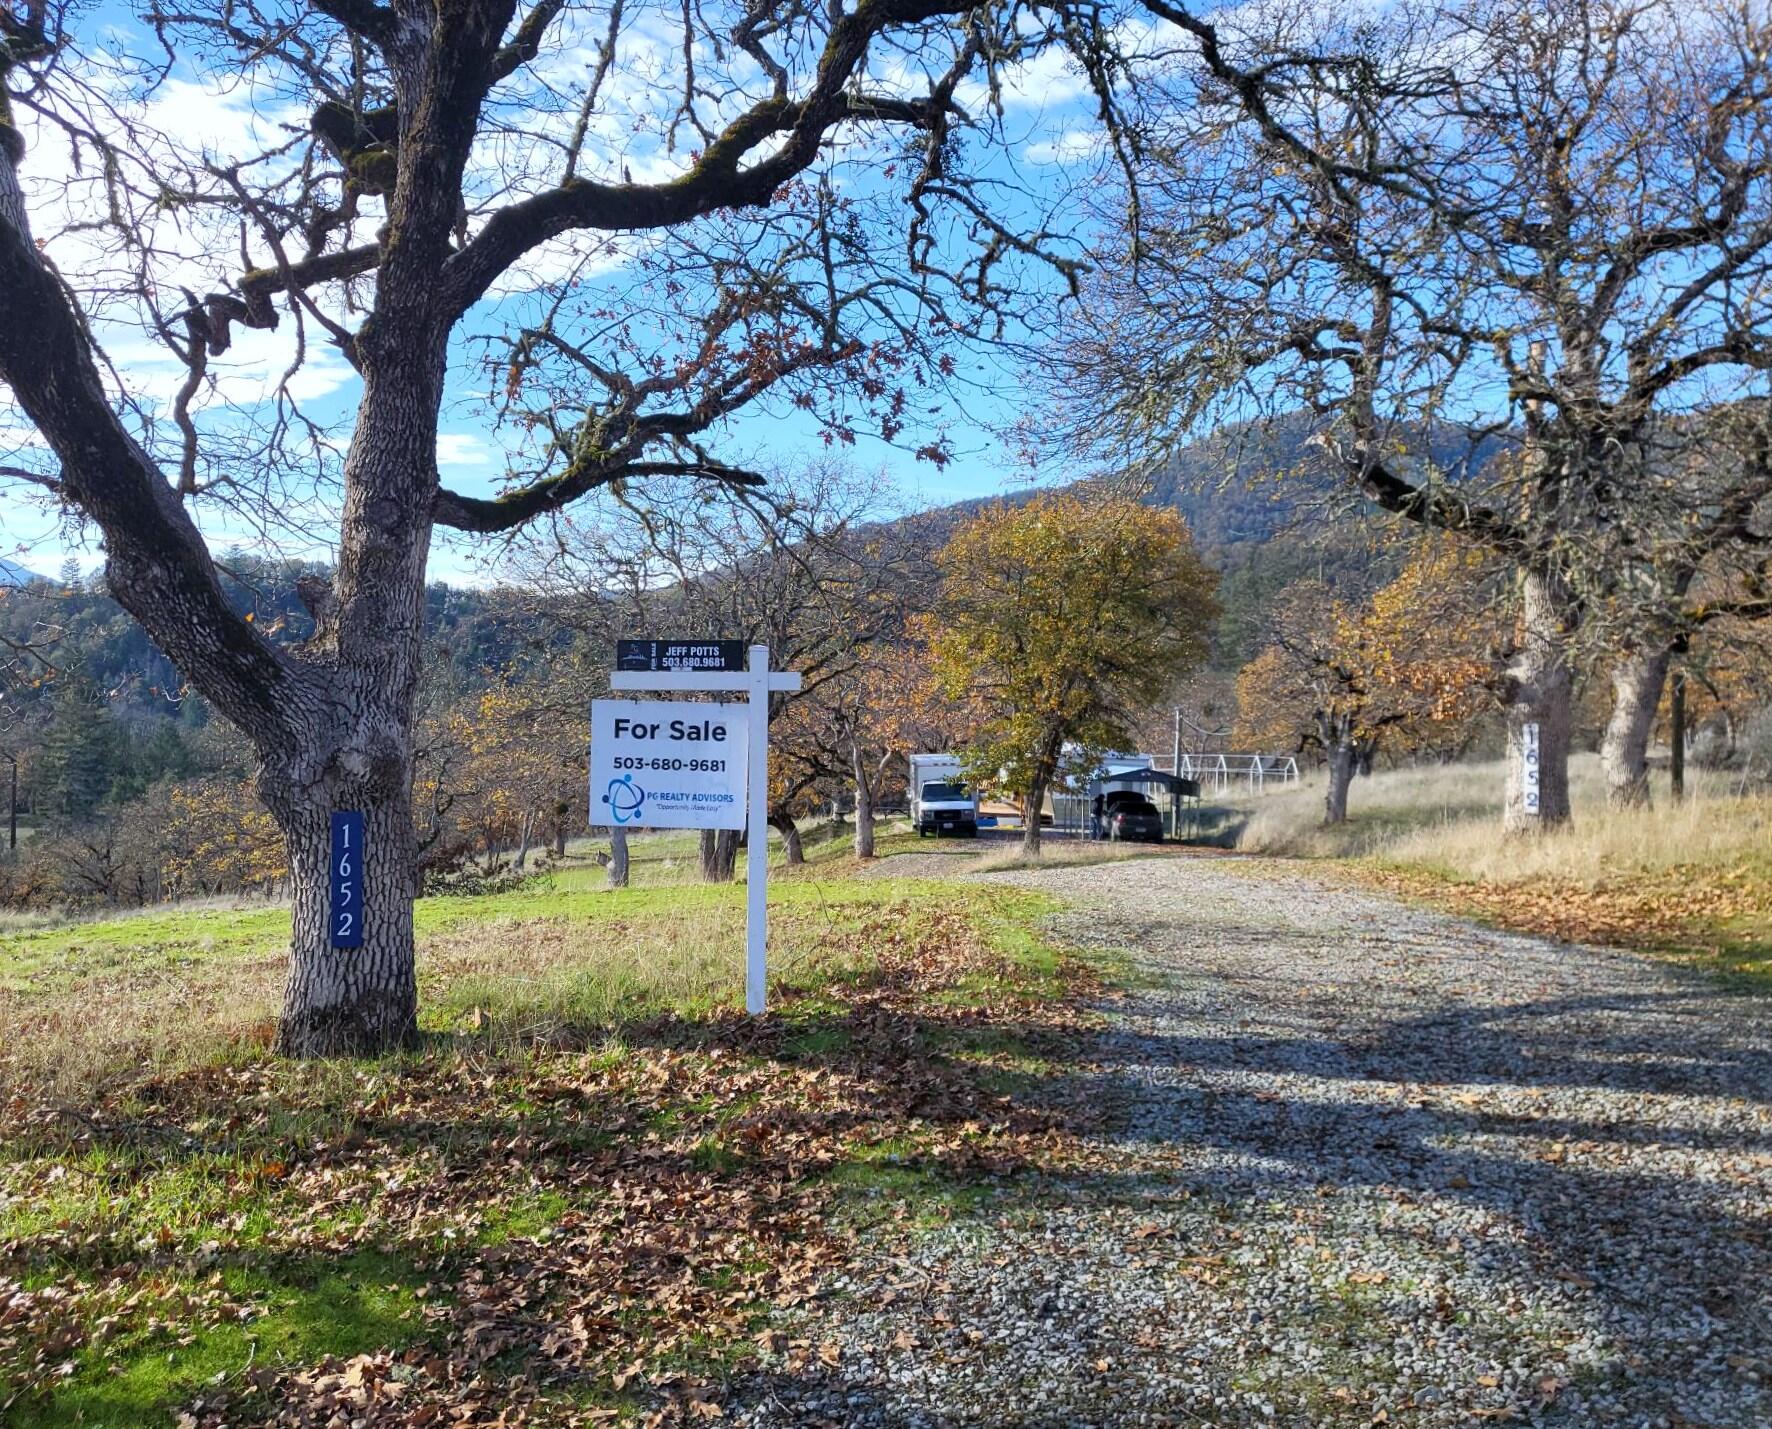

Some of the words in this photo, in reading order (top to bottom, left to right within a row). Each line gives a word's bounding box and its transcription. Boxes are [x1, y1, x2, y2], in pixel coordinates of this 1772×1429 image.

[665, 646, 688, 656] JEFF
[690, 646, 720, 656] POTTS
[662, 657, 725, 667] 503.680.9681
[614, 719, 660, 740] For
[670, 720, 727, 742] Sale
[613, 757, 726, 772] 503-680-9681
[1526, 727, 1539, 807] 1652
[647, 792, 659, 801] PG
[660, 792, 690, 802] REALTY
[692, 793, 734, 803] ADVISORS
[337, 823, 353, 936] 1652
